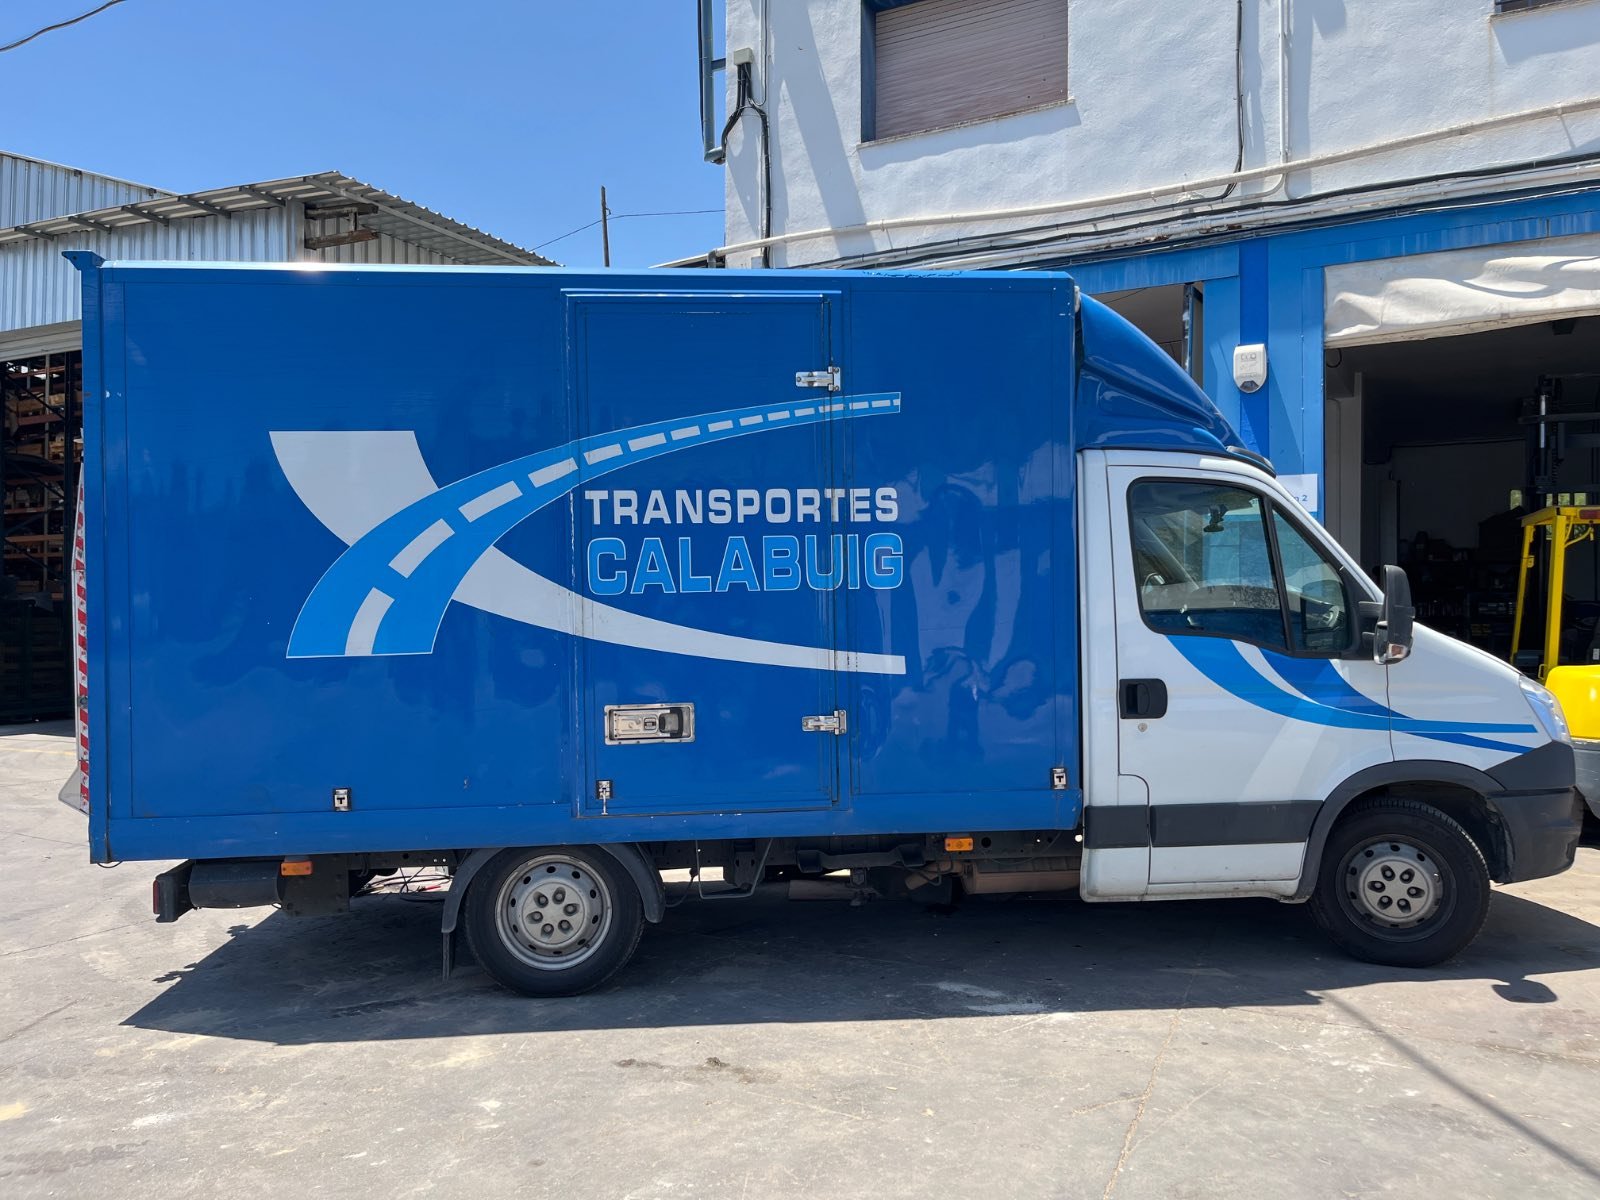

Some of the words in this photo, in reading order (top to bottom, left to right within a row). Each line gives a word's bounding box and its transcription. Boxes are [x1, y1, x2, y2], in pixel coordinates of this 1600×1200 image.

[584, 487, 899, 525] TRANSPORTES
[1302, 494, 1308, 502] 2
[587, 532, 904, 596] CALABUIG
